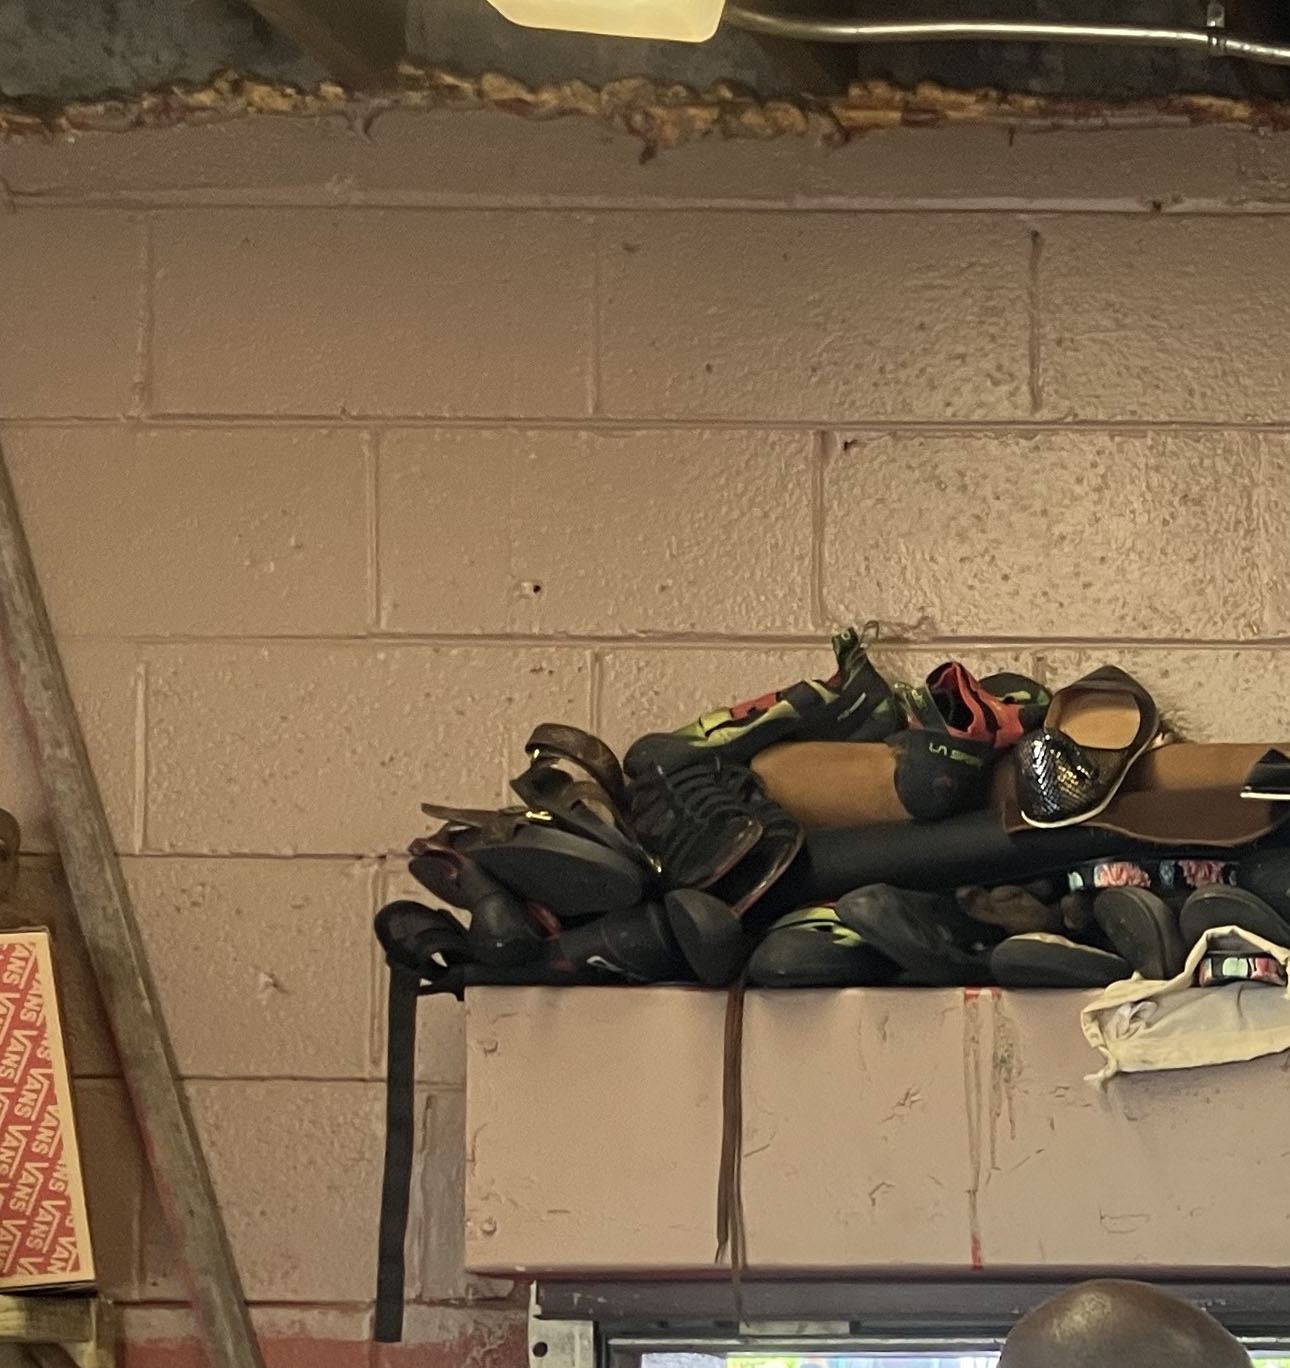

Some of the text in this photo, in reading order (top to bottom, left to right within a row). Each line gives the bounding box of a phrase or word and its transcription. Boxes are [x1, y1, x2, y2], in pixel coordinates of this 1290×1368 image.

[0, 1029, 39, 1083] VANS
[14, 1068, 54, 1121] VANS
[9, 1162, 49, 1215] VANS
[26, 1200, 66, 1253] VANS
